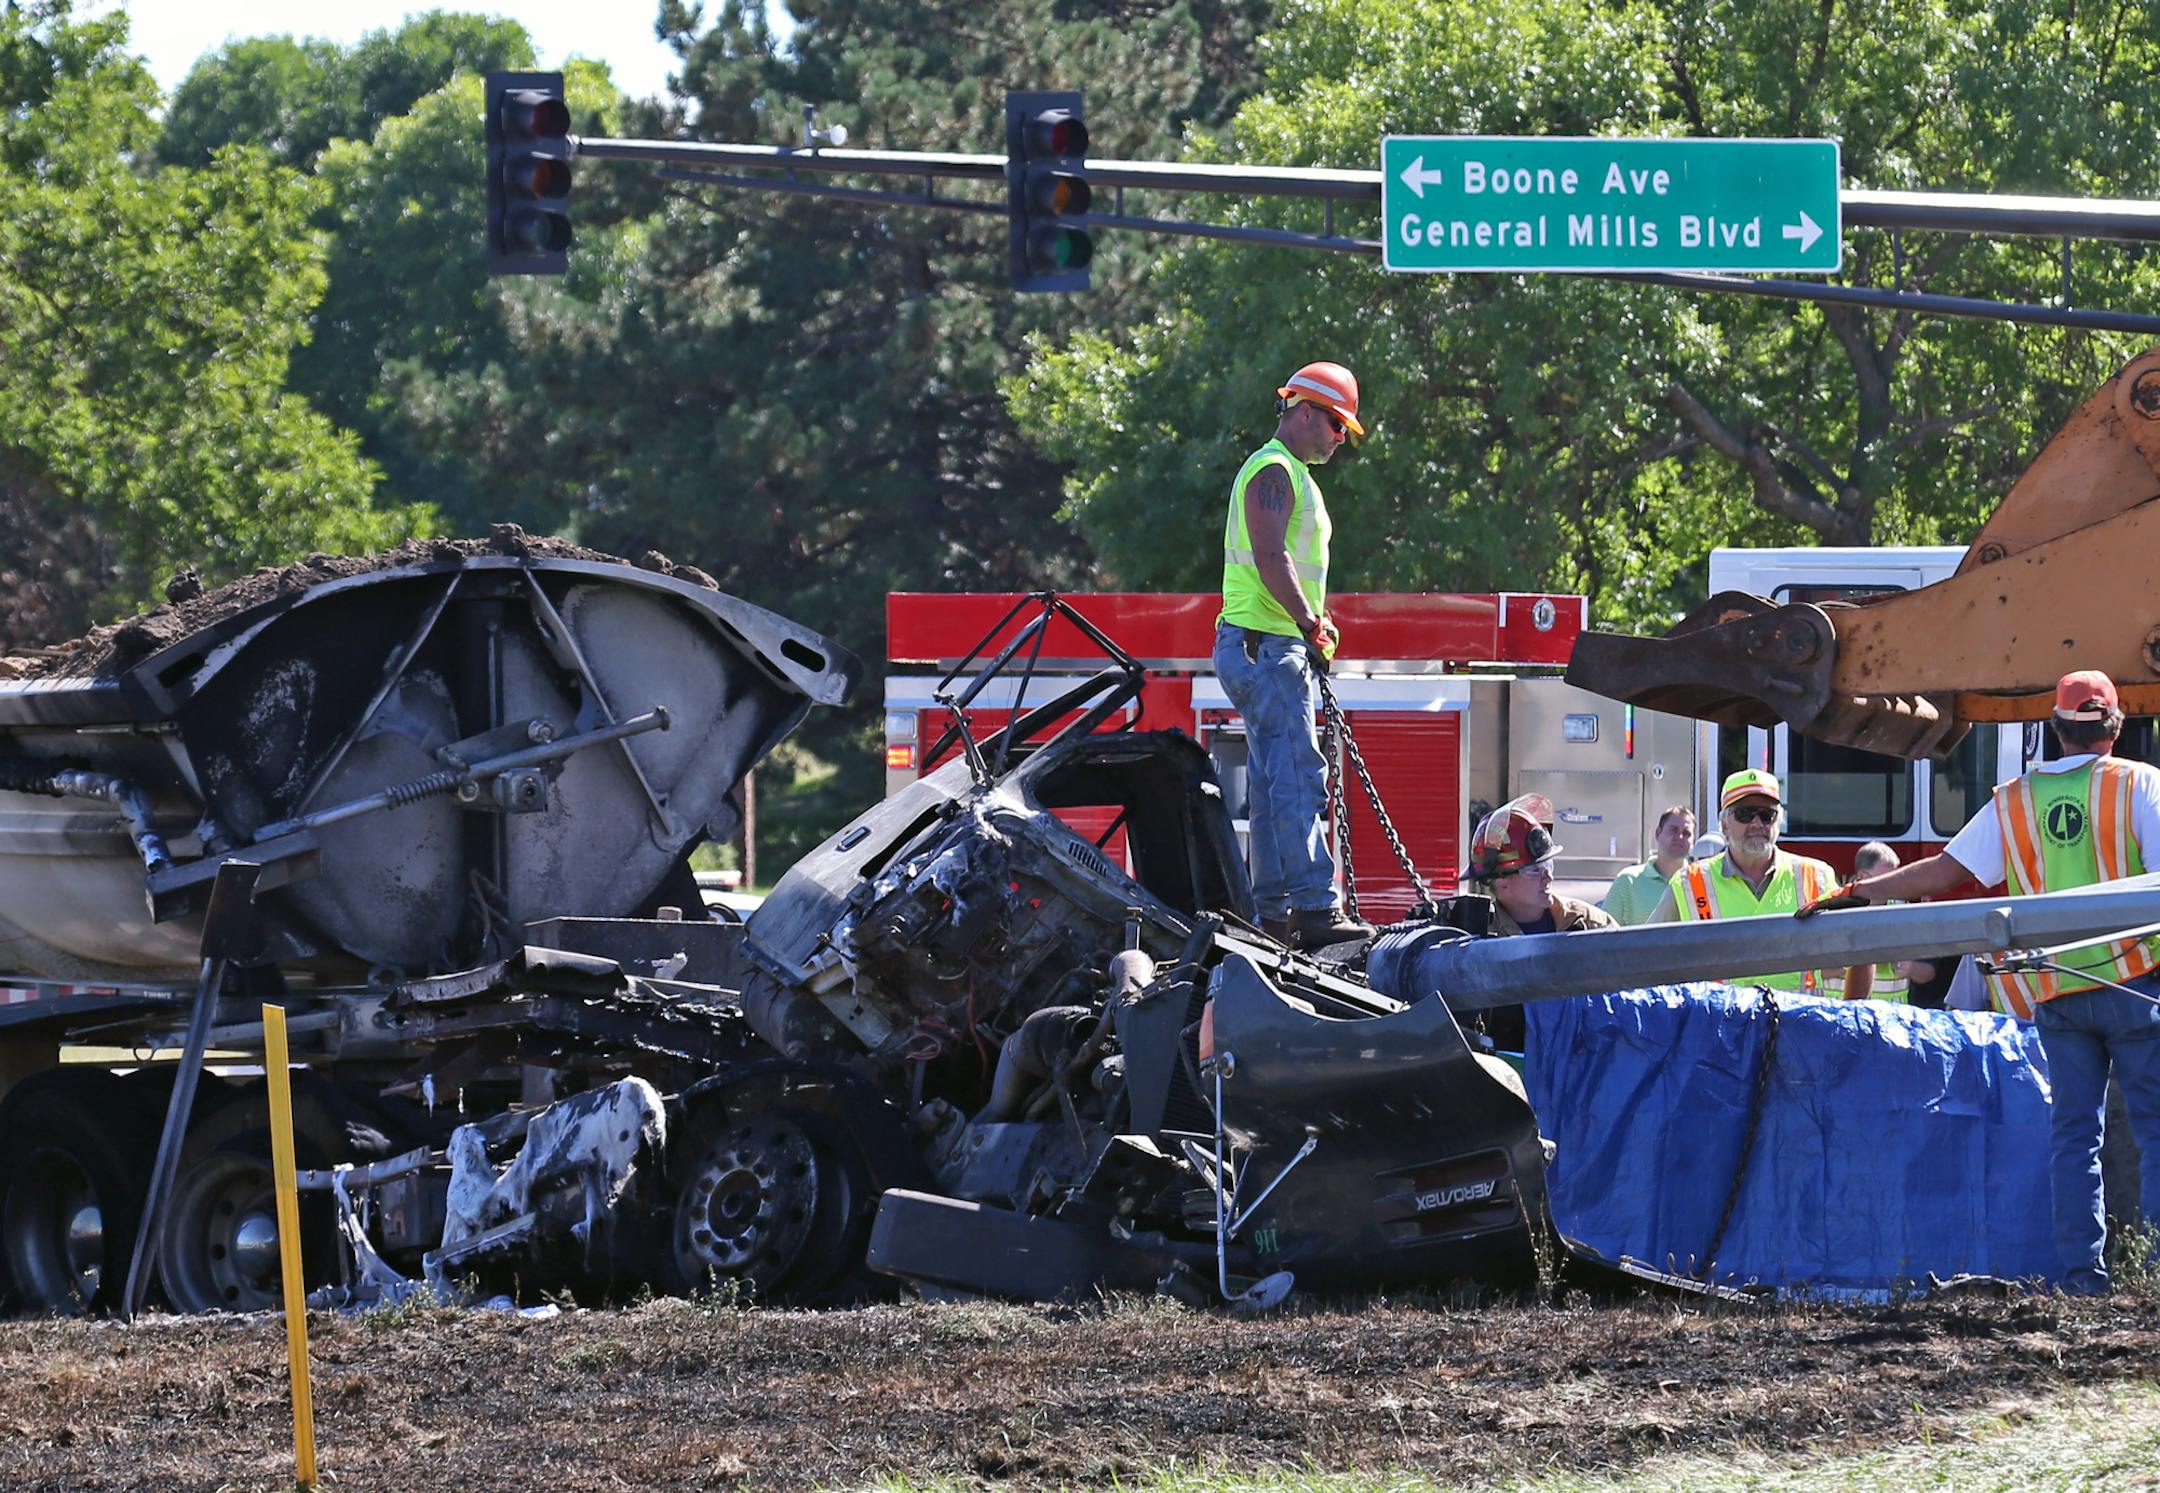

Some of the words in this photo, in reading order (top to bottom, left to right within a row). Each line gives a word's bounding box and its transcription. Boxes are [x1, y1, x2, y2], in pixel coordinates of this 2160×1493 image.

[1464, 161, 1578, 194] Boone
[1602, 161, 1670, 195] Ave
[1401, 213, 1546, 247] General
[1568, 214, 1658, 247] Mills
[1680, 215, 1761, 247] Blvd
